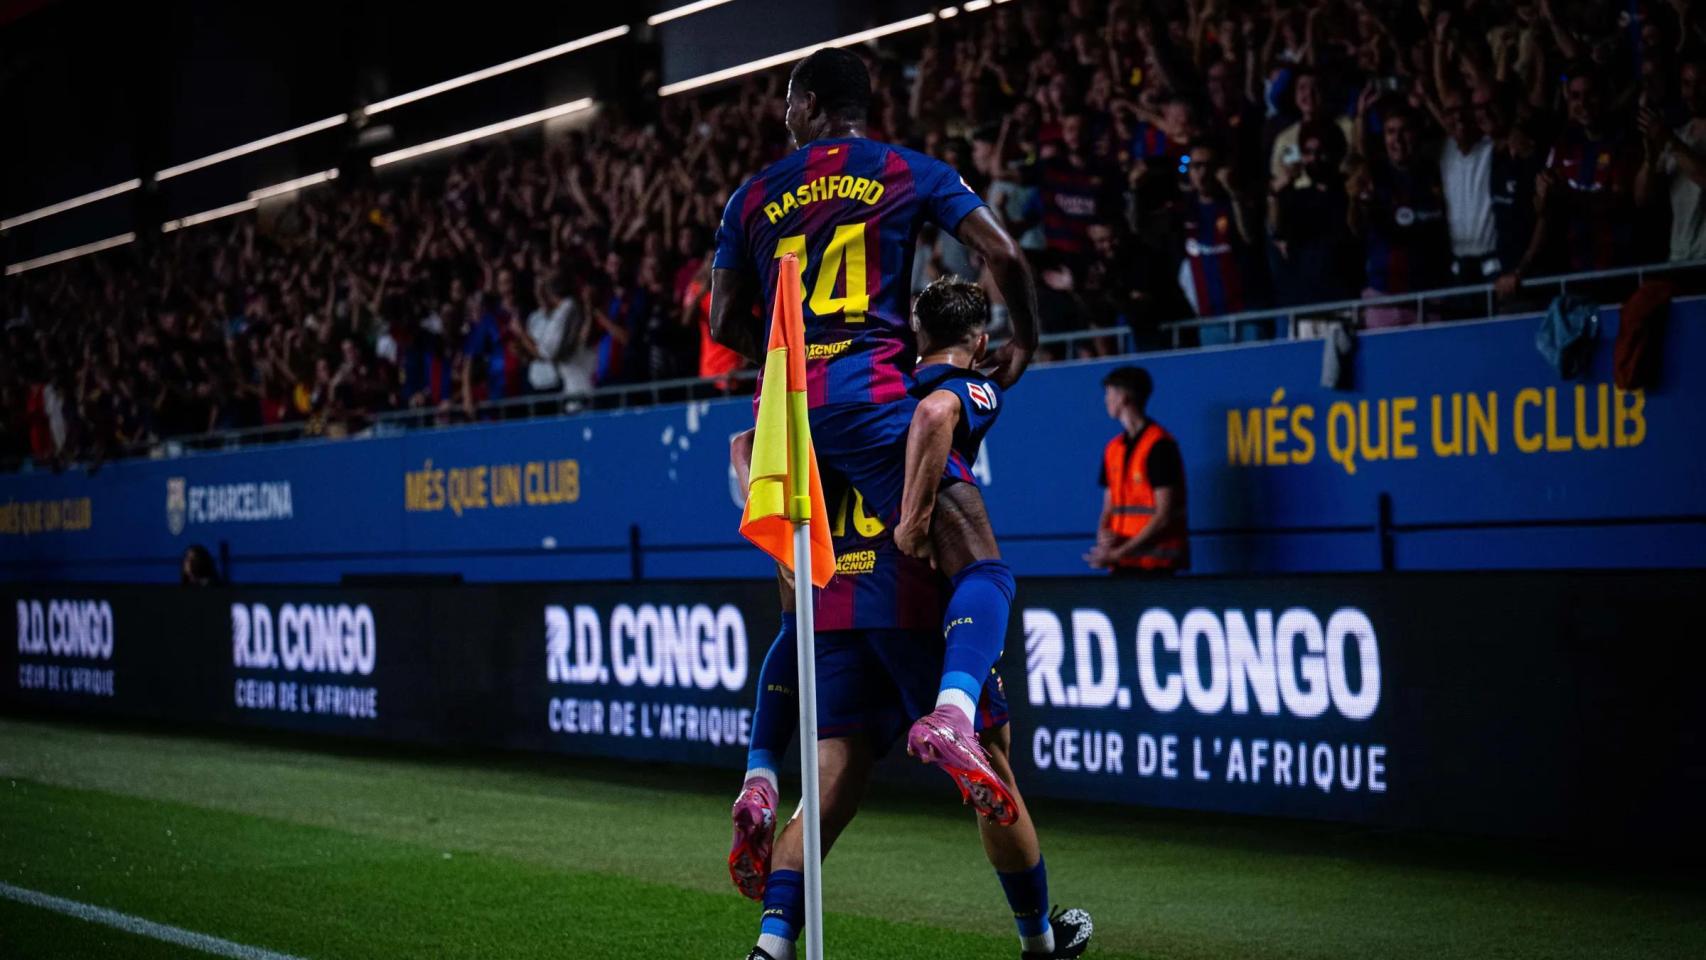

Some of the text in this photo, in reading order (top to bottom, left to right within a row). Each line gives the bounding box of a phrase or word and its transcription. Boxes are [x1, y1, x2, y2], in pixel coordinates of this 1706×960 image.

[763, 175, 885, 225] RASHFORD
[1227, 382, 1647, 475] MÉS QUE UN CLUB
[188, 480, 294, 523] FC BARCELONA
[404, 458, 581, 518] MÉS QUE UN CLUB
[836, 561, 875, 571] ACNUR
[837, 550, 877, 563] UNHCR
[48, 597, 114, 661] CONGO
[231, 602, 377, 675] R.D. CONGO
[544, 602, 749, 692] R.D. CONGO
[1022, 606, 1381, 720] R.D. CONGO
[278, 681, 298, 712] DE
[610, 701, 636, 737] DE
[1137, 734, 1178, 778] DE
